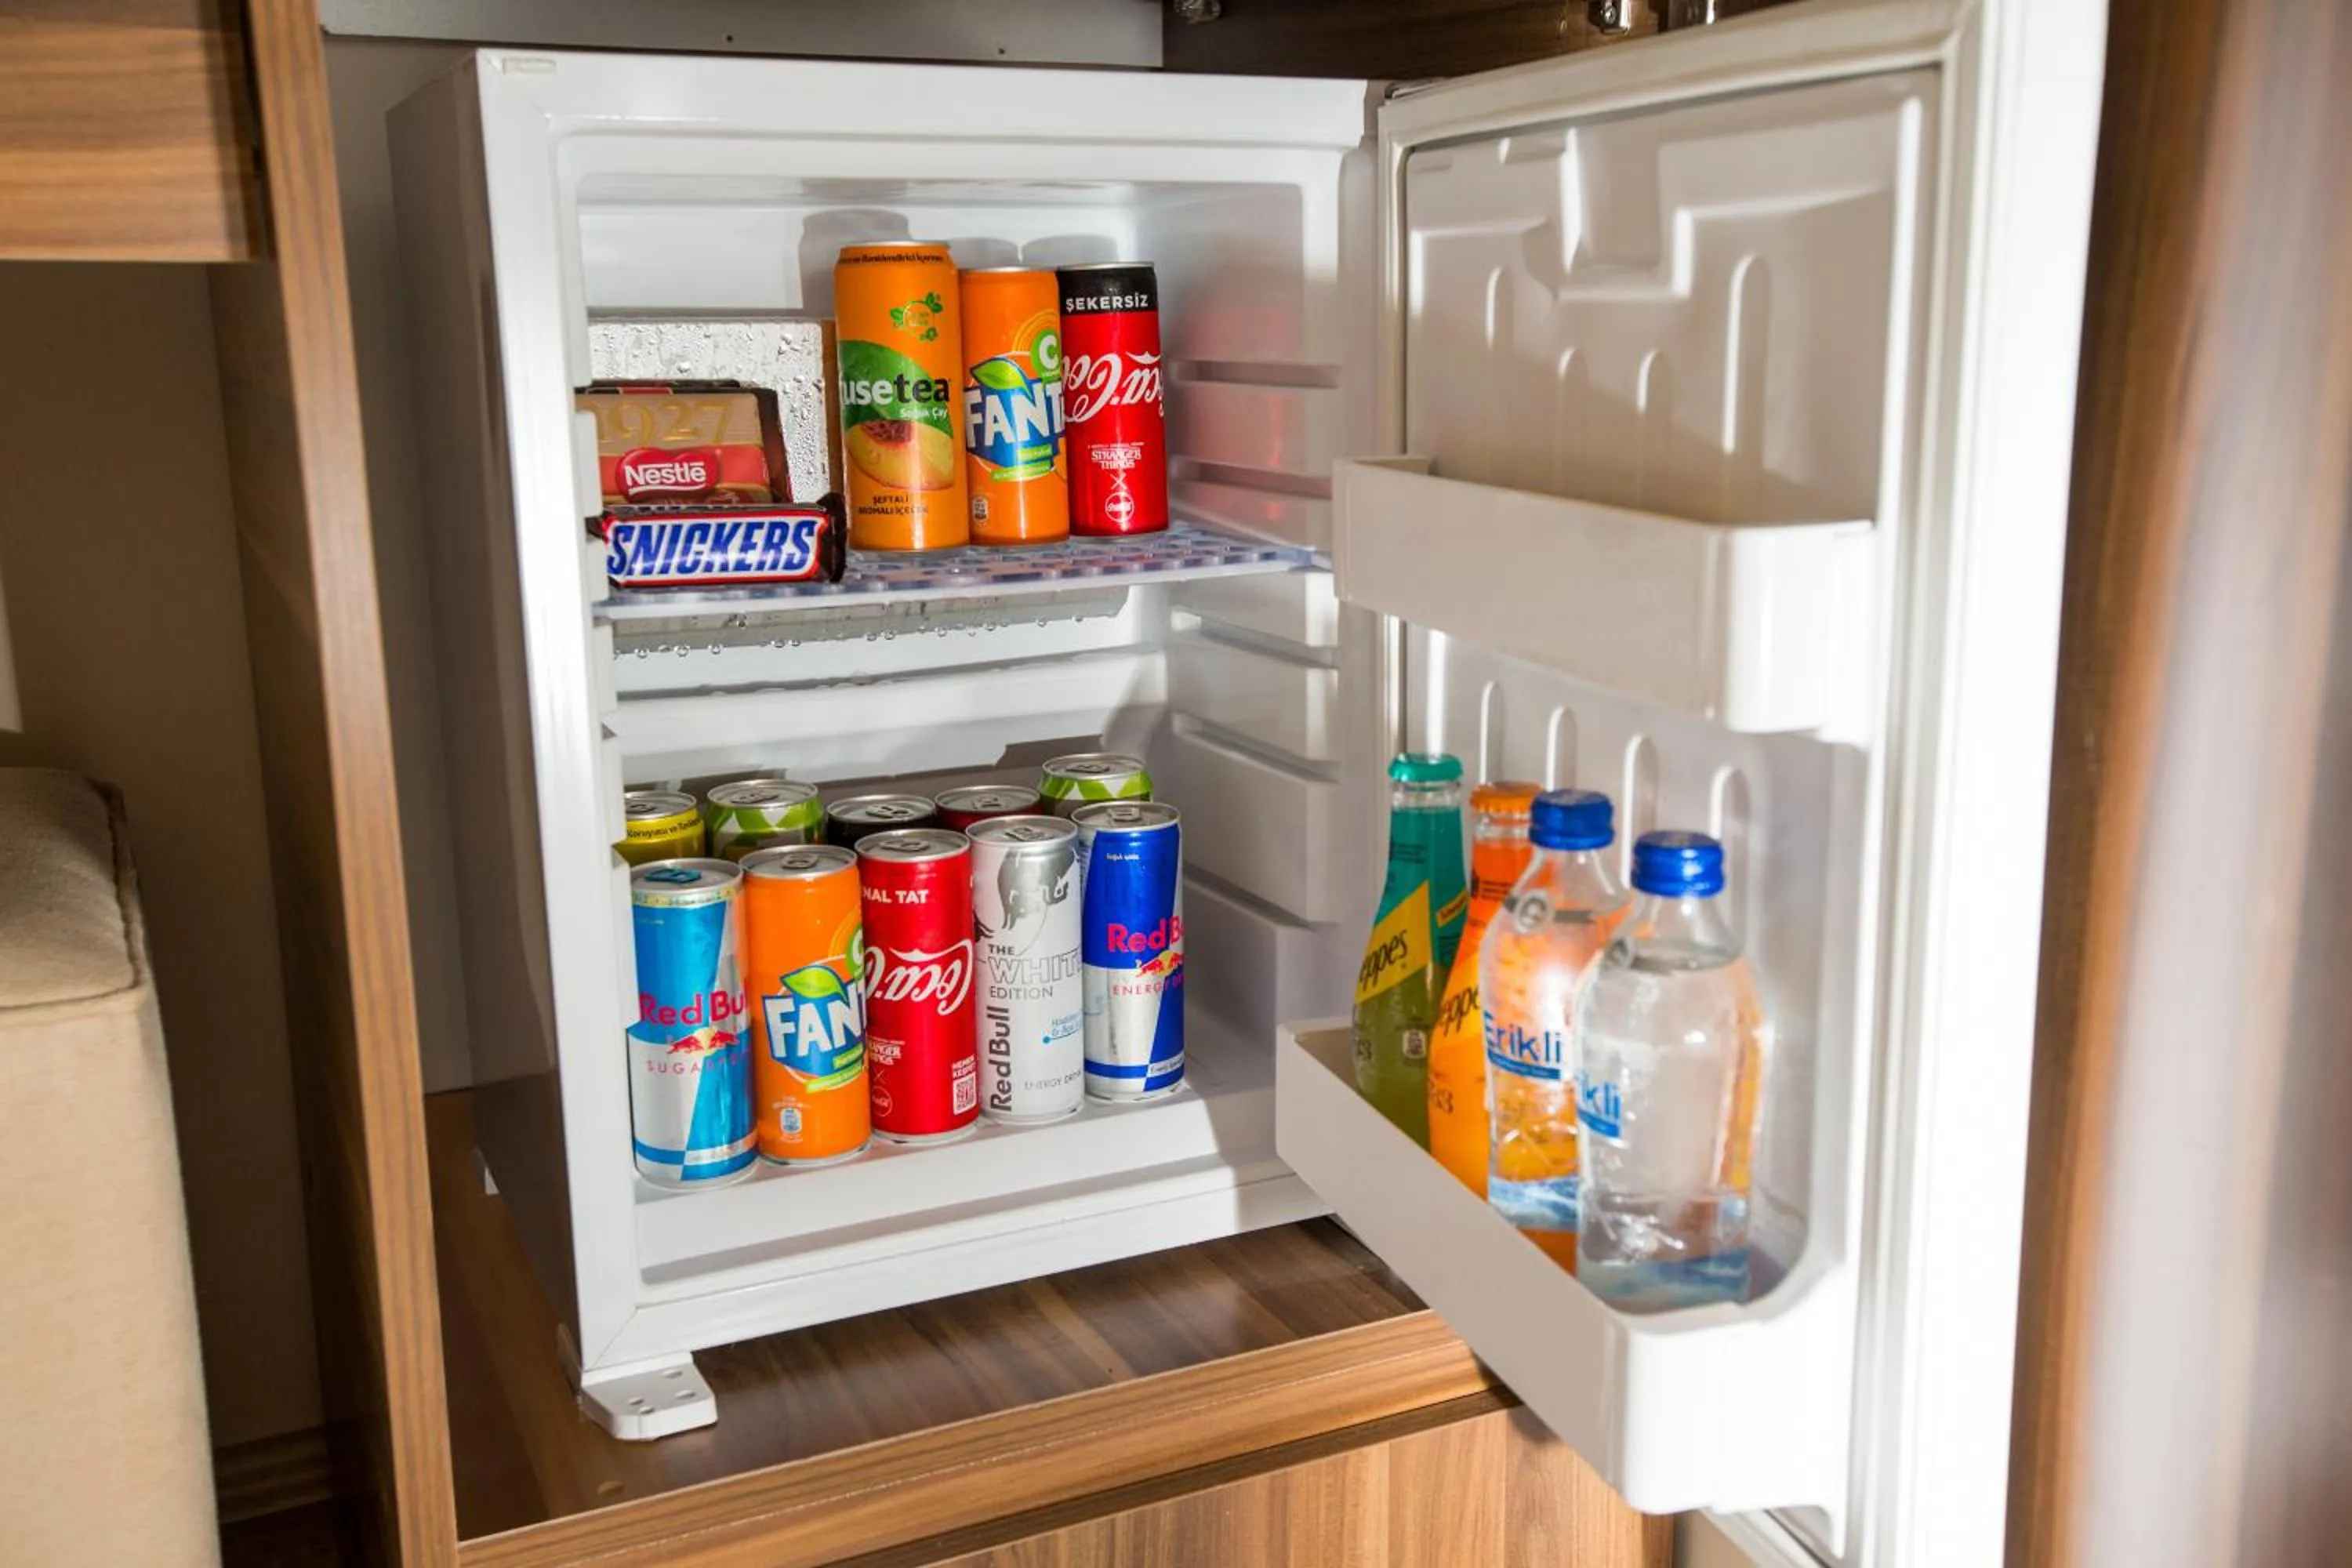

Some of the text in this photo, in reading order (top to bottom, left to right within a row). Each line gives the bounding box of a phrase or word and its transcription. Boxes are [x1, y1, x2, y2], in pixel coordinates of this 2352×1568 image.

[1066, 293, 1148, 313] ŞEKERSİZ
[607, 520, 818, 576] SNICKERS
[895, 890, 929, 904] TAT
[989, 944, 1015, 956] THE
[1107, 918, 1167, 953] Red
[988, 951, 1082, 985] WHIT
[640, 985, 747, 1026] Red Bu
[990, 985, 1053, 1000] EDITION
[986, 1006, 1012, 1112] Red Bull
